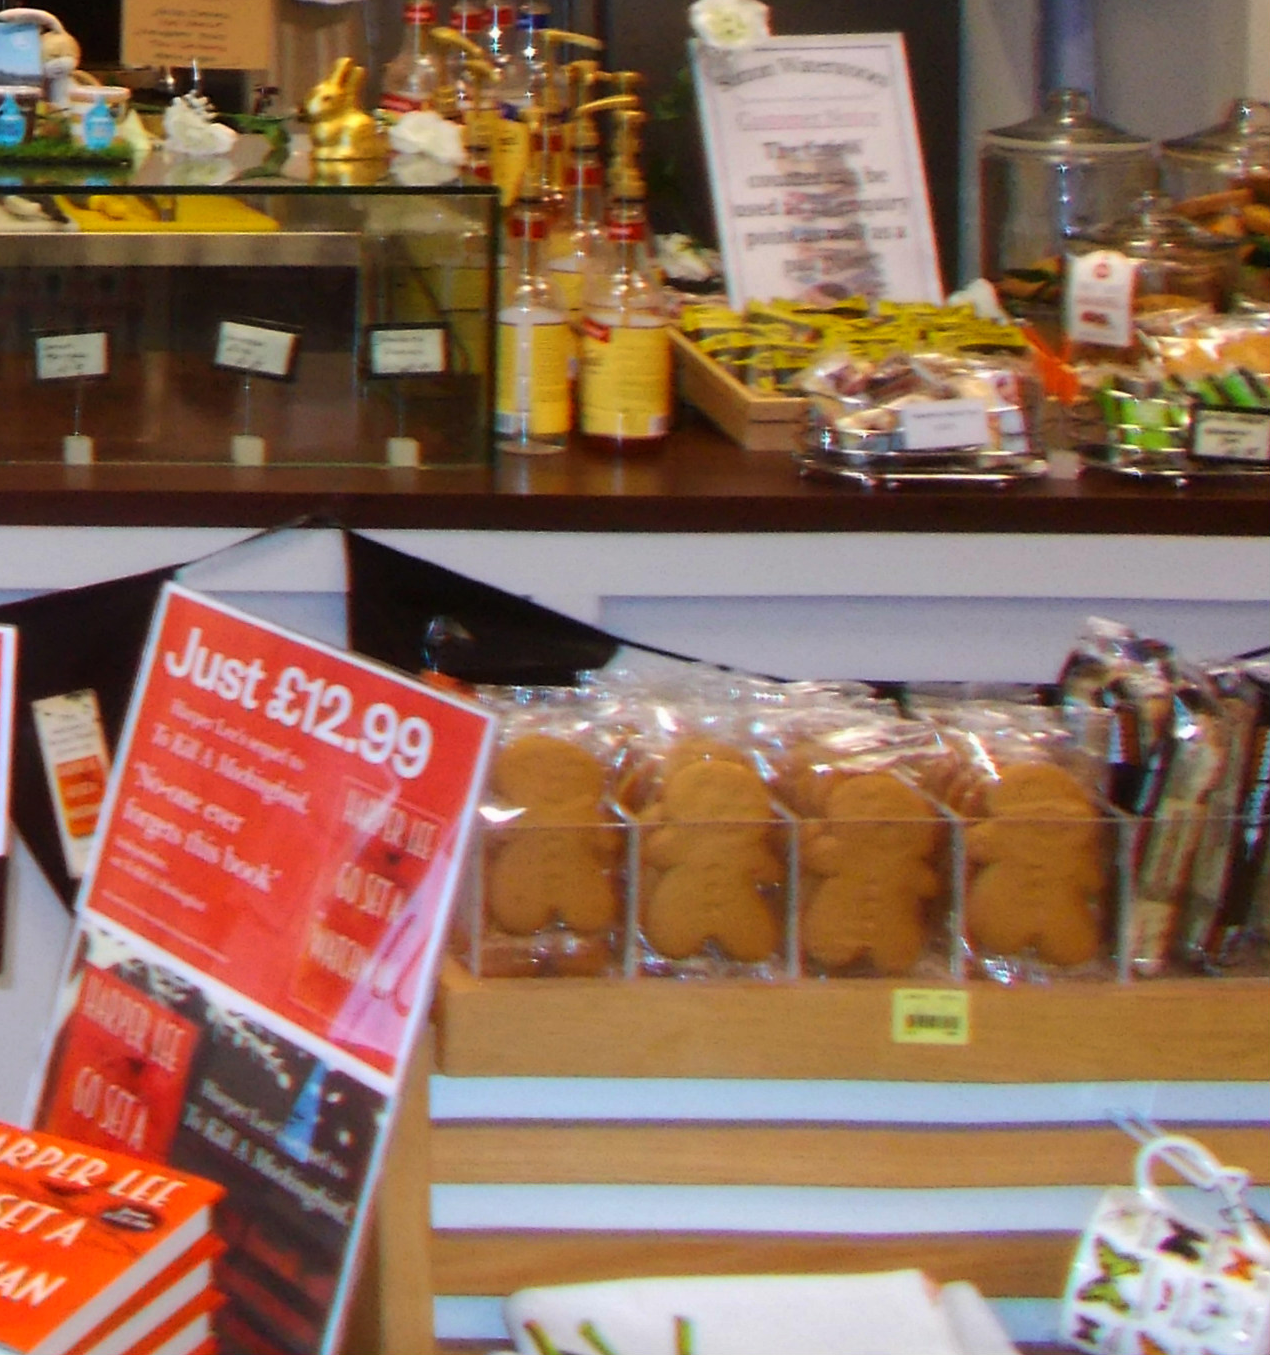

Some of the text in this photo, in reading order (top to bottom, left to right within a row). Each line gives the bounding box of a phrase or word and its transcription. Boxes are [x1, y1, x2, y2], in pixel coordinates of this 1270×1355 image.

[165, 627, 433, 780] Just £12.99
[106, 1168, 188, 1210] LEE
[44, 1217, 89, 1249] A
